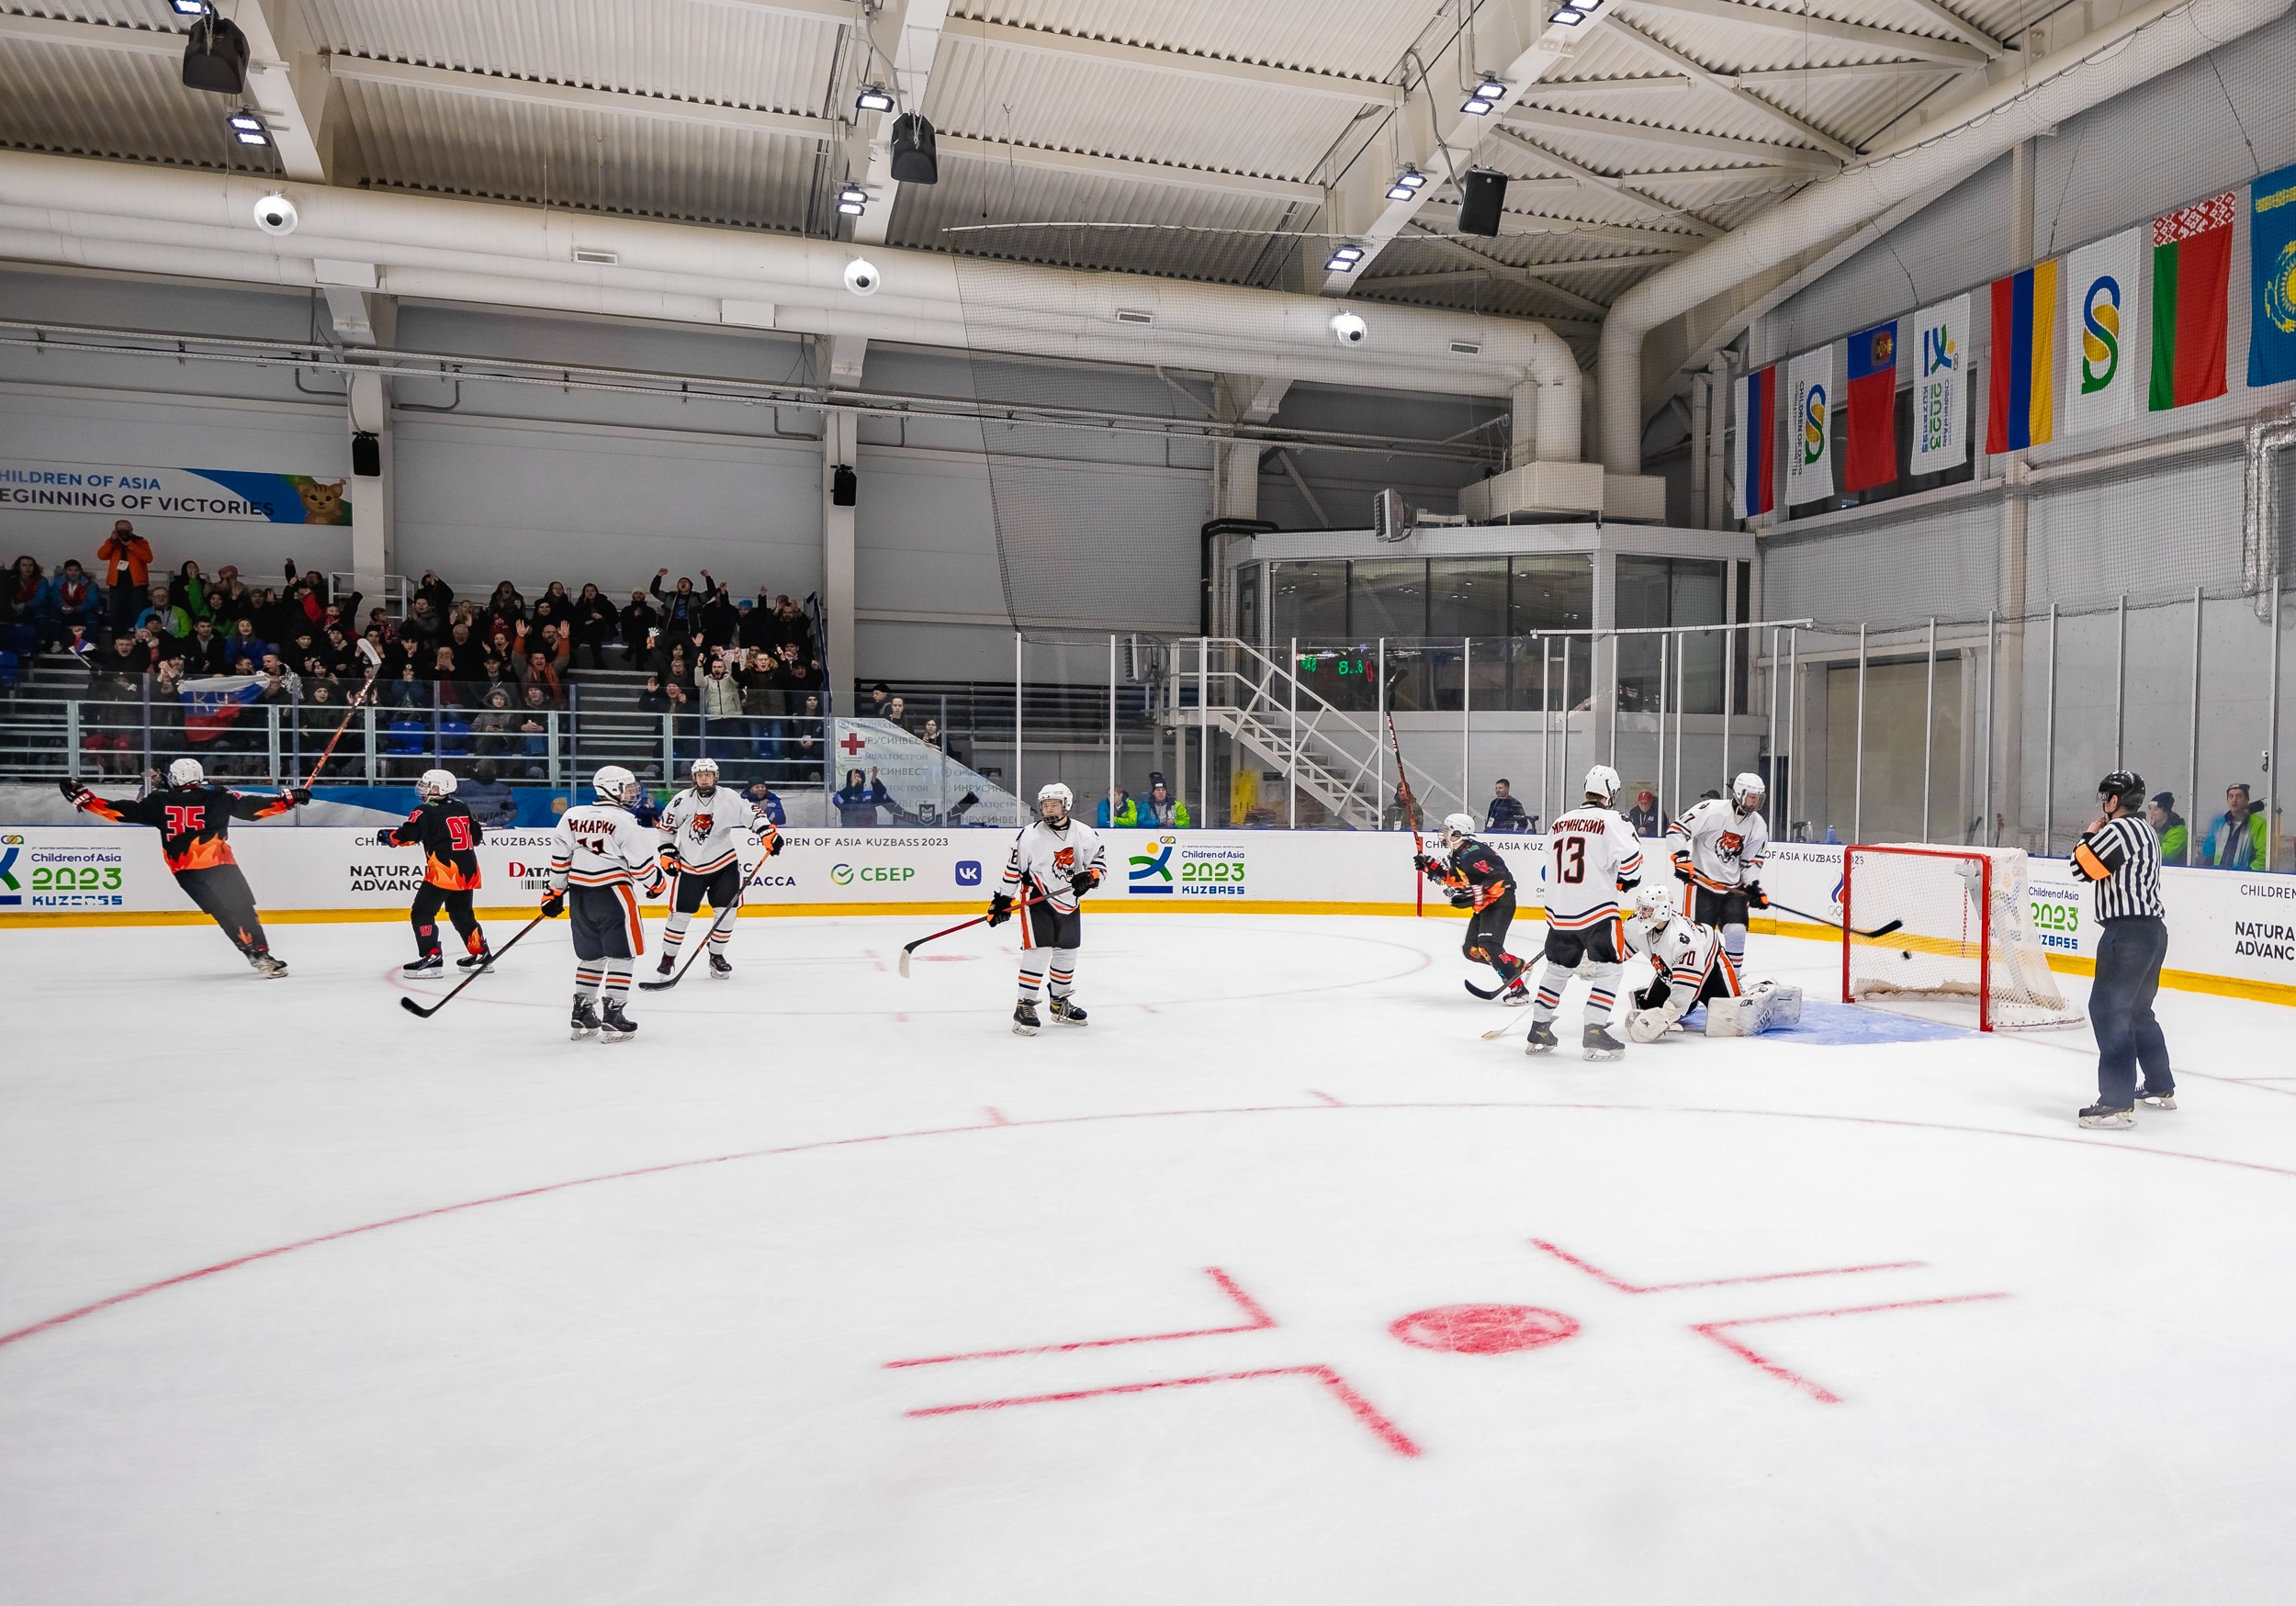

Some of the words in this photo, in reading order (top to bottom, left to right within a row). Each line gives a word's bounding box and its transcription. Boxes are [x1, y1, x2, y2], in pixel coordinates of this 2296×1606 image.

[1930, 383, 1941, 450] 2023
[87, 475, 114, 488] OF
[118, 477, 161, 490] ASIA
[121, 495, 152, 510] OF
[158, 497, 275, 516] VICTORIES
[165, 805, 206, 842] 35
[490, 837, 552, 847] KUZBASS
[748, 837, 810, 847] CHREN
[815, 837, 831, 847] OF
[835, 837, 862, 847] ASIA
[866, 837, 919, 847] KUZBASS
[921, 837, 949, 847] 2023
[1497, 842, 1521, 850] ASIA
[31, 853, 82, 862] Children
[83, 853, 95, 862] of
[96, 853, 122, 862] Asia
[1181, 850, 1217, 859] Children
[1217, 850, 1226, 859] of
[1227, 850, 1245, 859] Asia
[1552, 837, 1586, 884] 13
[1765, 850, 1777, 859] OF
[1779, 851, 1800, 861] ASIA
[1803, 853, 1841, 863] KUZBASS
[32, 867, 122, 891] 2023
[861, 867, 916, 882] СБЕР
[959, 867, 978, 880] VK
[1182, 862, 1245, 882] 2023
[1182, 886, 1245, 894] KUZBASS
[2028, 886, 2056, 898] Children
[2056, 890, 2064, 899] of
[2064, 890, 2079, 901] Asia
[2031, 902, 2078, 932] 2023
[2234, 921, 2296, 941] NATURA
[2039, 934, 2078, 949] ZBASS
[2234, 939, 2295, 961] ADVANC
